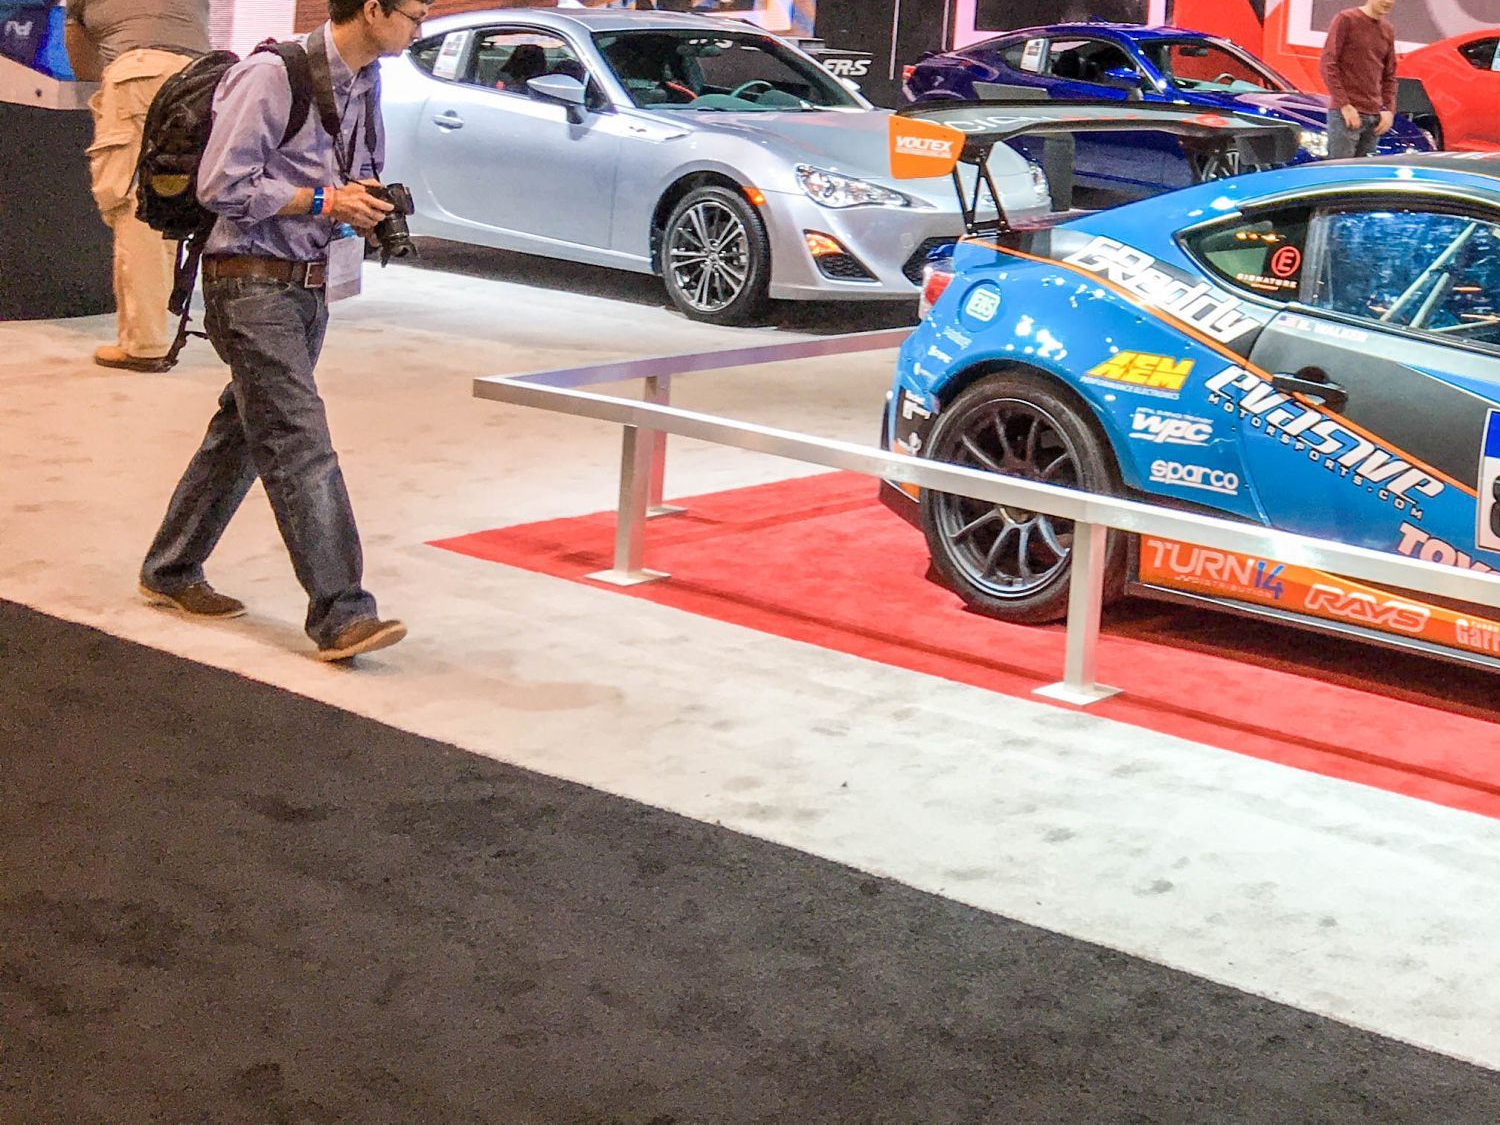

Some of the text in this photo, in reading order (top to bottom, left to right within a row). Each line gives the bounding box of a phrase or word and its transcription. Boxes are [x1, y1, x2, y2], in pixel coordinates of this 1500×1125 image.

[895, 135, 953, 152] VOLTEX
[1277, 251, 1295, 272] E
[1086, 351, 1195, 393] AEM
[1208, 392, 1424, 520] MOTORSPORTS.COM
[1150, 459, 1239, 490] sparco
[1304, 583, 1431, 633] RAYS
